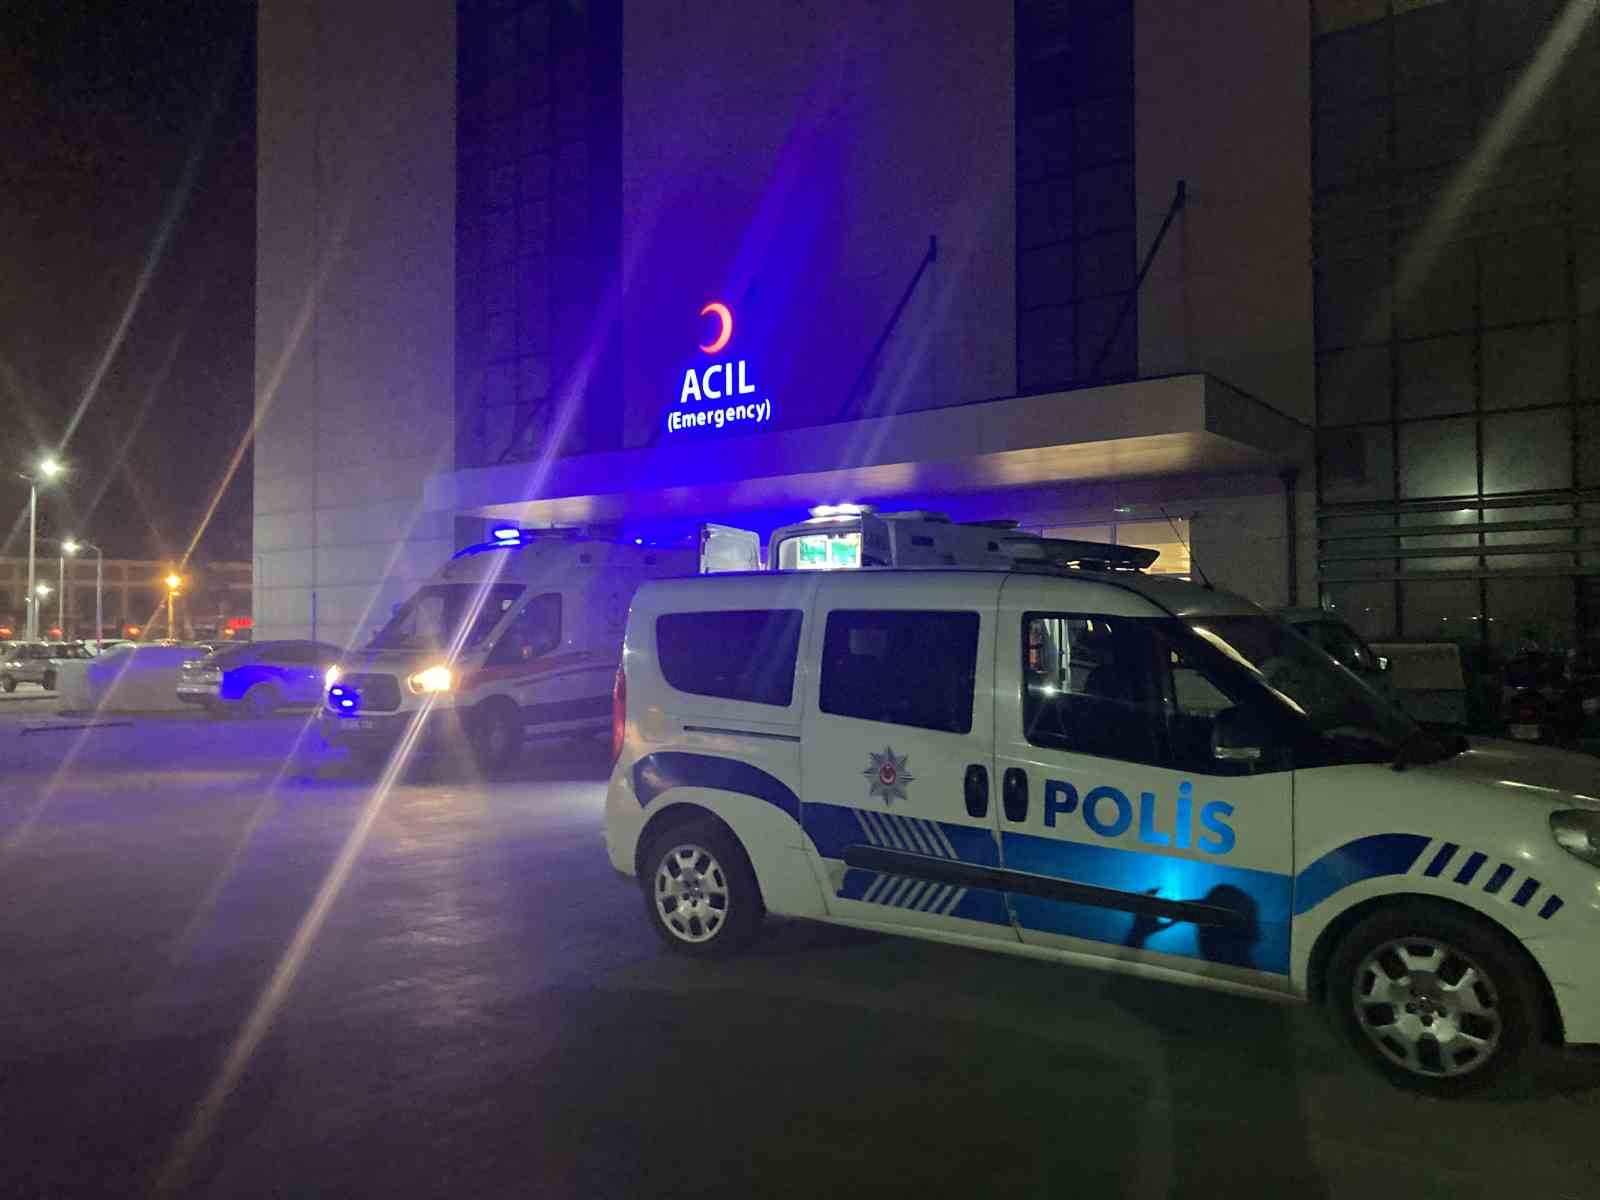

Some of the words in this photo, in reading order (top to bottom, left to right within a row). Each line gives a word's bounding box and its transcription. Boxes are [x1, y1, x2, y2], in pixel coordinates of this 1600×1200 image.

[680, 360, 755, 403] ACIL
[667, 398, 771, 432] (Emergency)
[1043, 779, 1236, 855] POLİS
